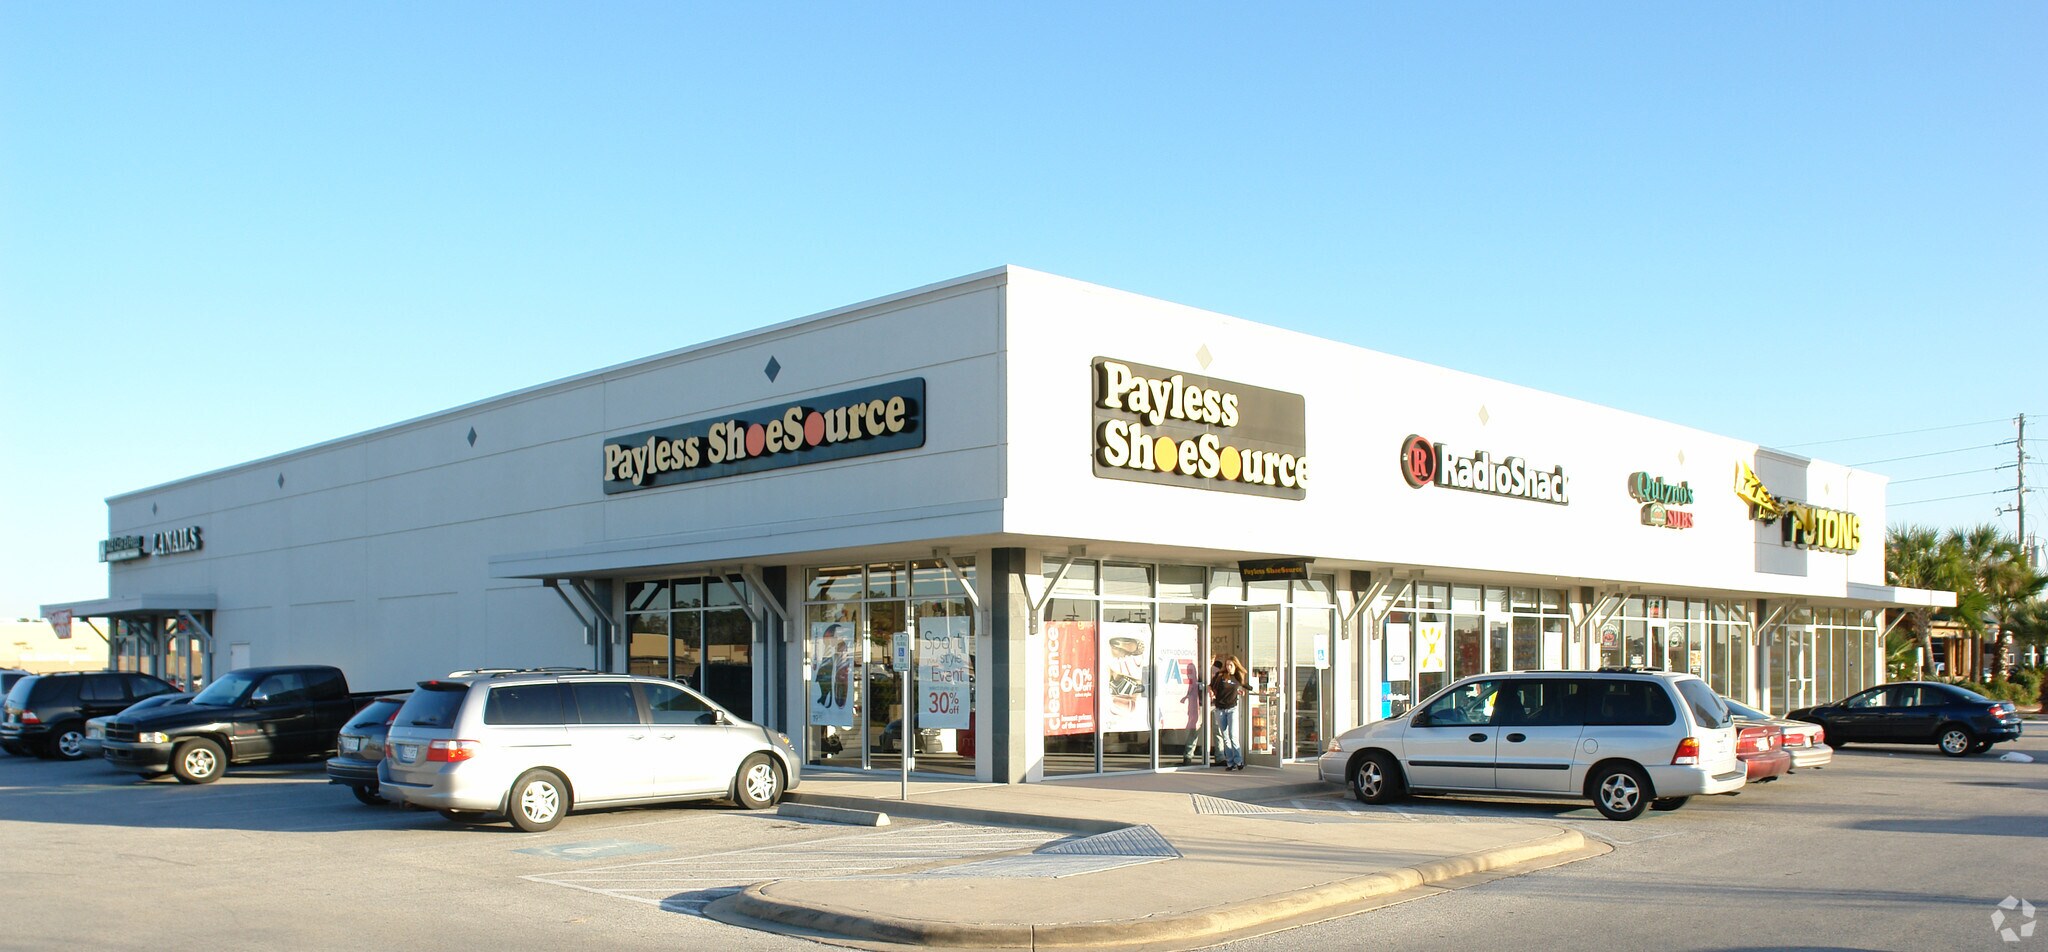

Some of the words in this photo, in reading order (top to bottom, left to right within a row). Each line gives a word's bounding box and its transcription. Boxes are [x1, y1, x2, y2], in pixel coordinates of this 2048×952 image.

[1104, 360, 1239, 427] Payless
[604, 435, 700, 486] Payless
[707, 395, 906, 464] ShoeSource
[1104, 418, 1310, 490] ShoeSource
[1666, 509, 1693, 529] SUBS
[924, 630, 964, 655] Sport
[931, 663, 964, 683] Event
[1044, 626, 1061, 731] clearance
